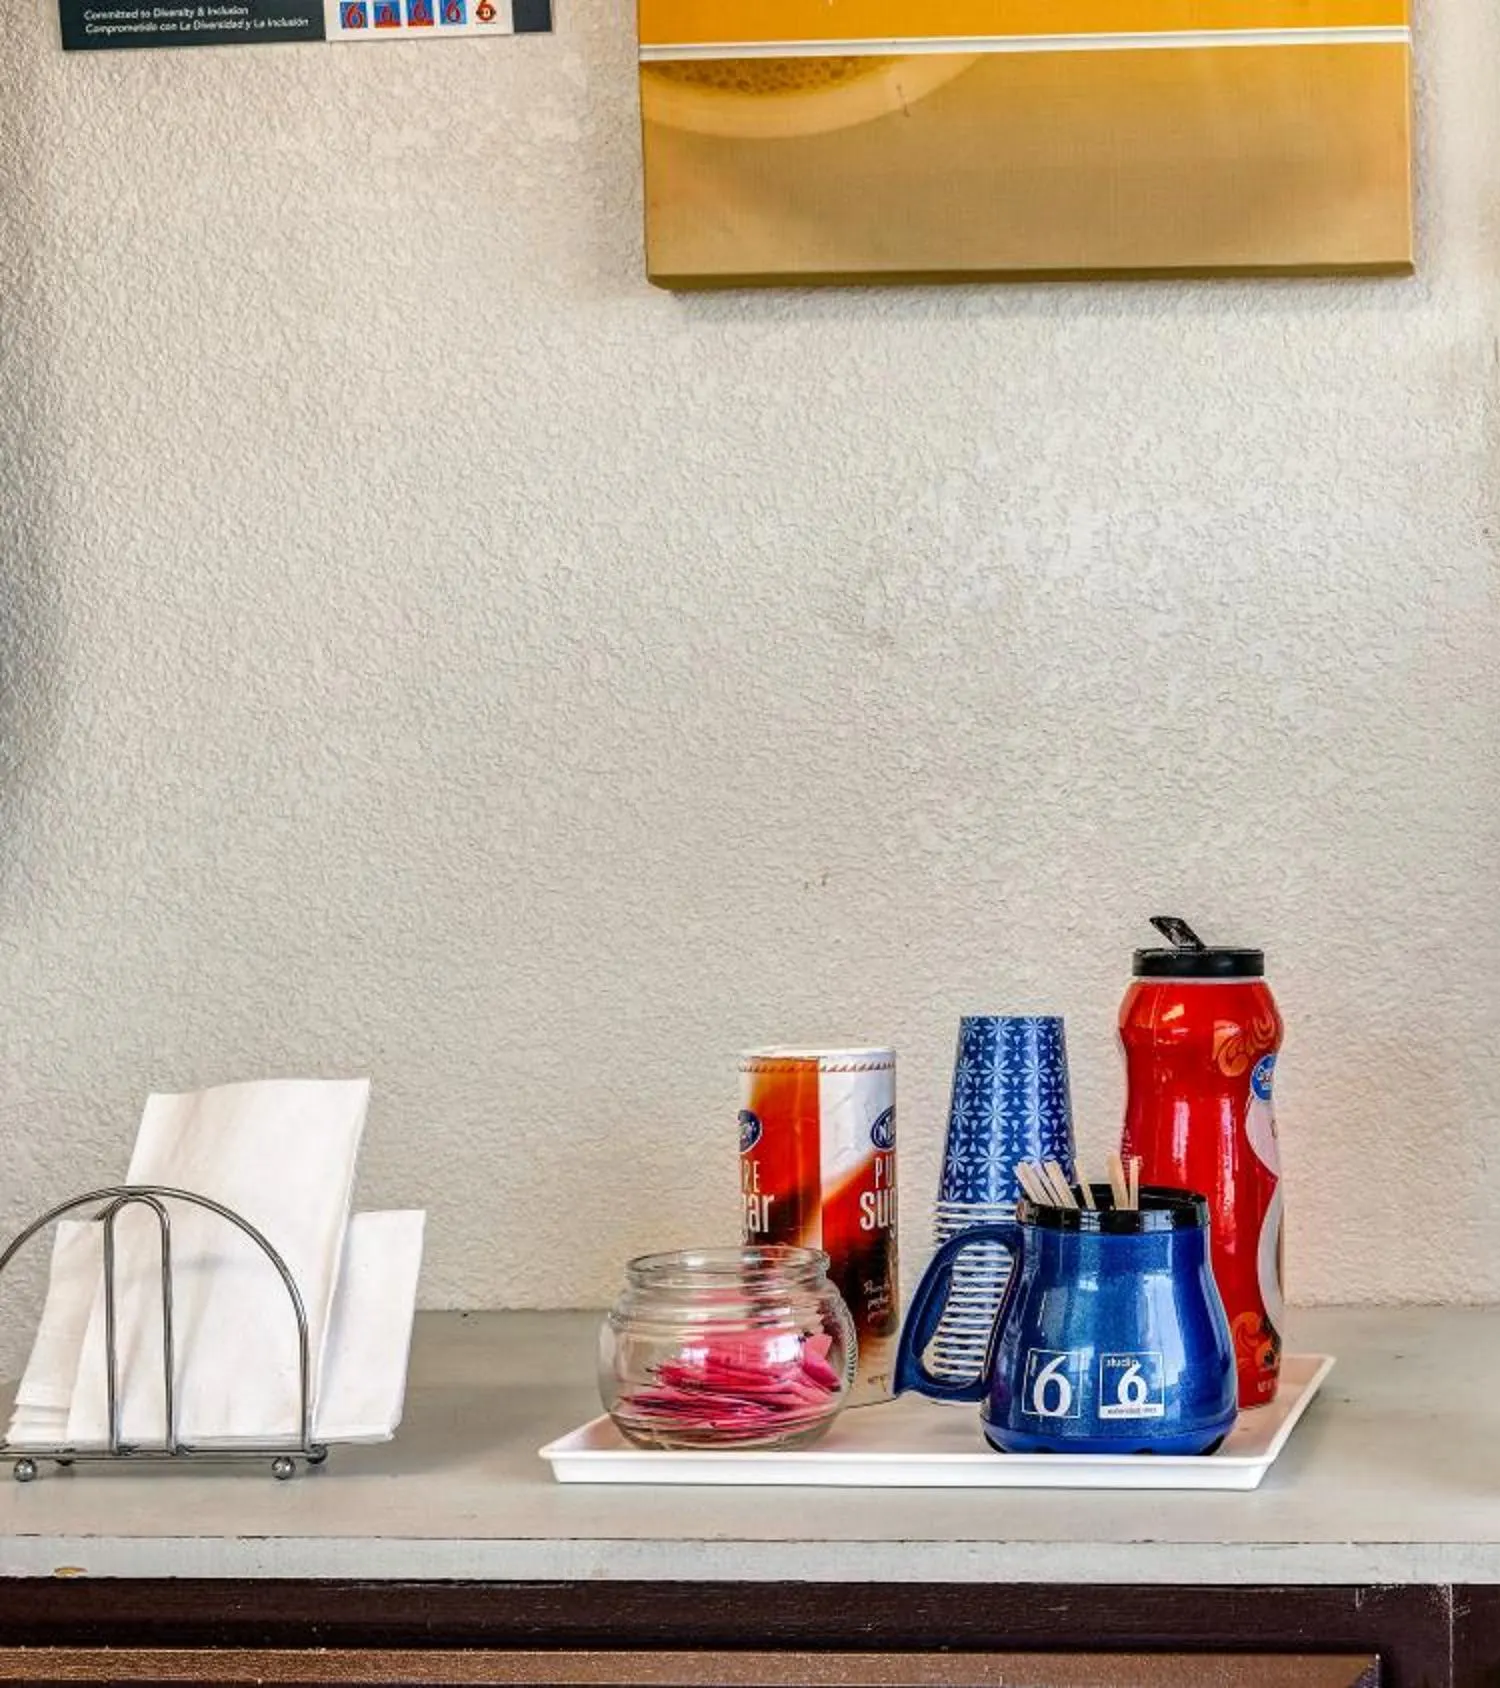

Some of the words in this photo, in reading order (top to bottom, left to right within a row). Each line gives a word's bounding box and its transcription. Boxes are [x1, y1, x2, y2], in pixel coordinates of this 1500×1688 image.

[84, 10, 138, 20] Committed
[141, 10, 151, 18] to
[153, 8, 195, 19] Diversity
[207, 6, 249, 16] Inclusion
[85, 23, 158, 36] Comprometido
[160, 22, 177, 31] con
[179, 21, 191, 31] La
[193, 18, 243, 31] Diversidad
[254, 18, 265, 28] La
[1034, 1356, 1072, 1415] 6
[1118, 1362, 1147, 1406] 6
